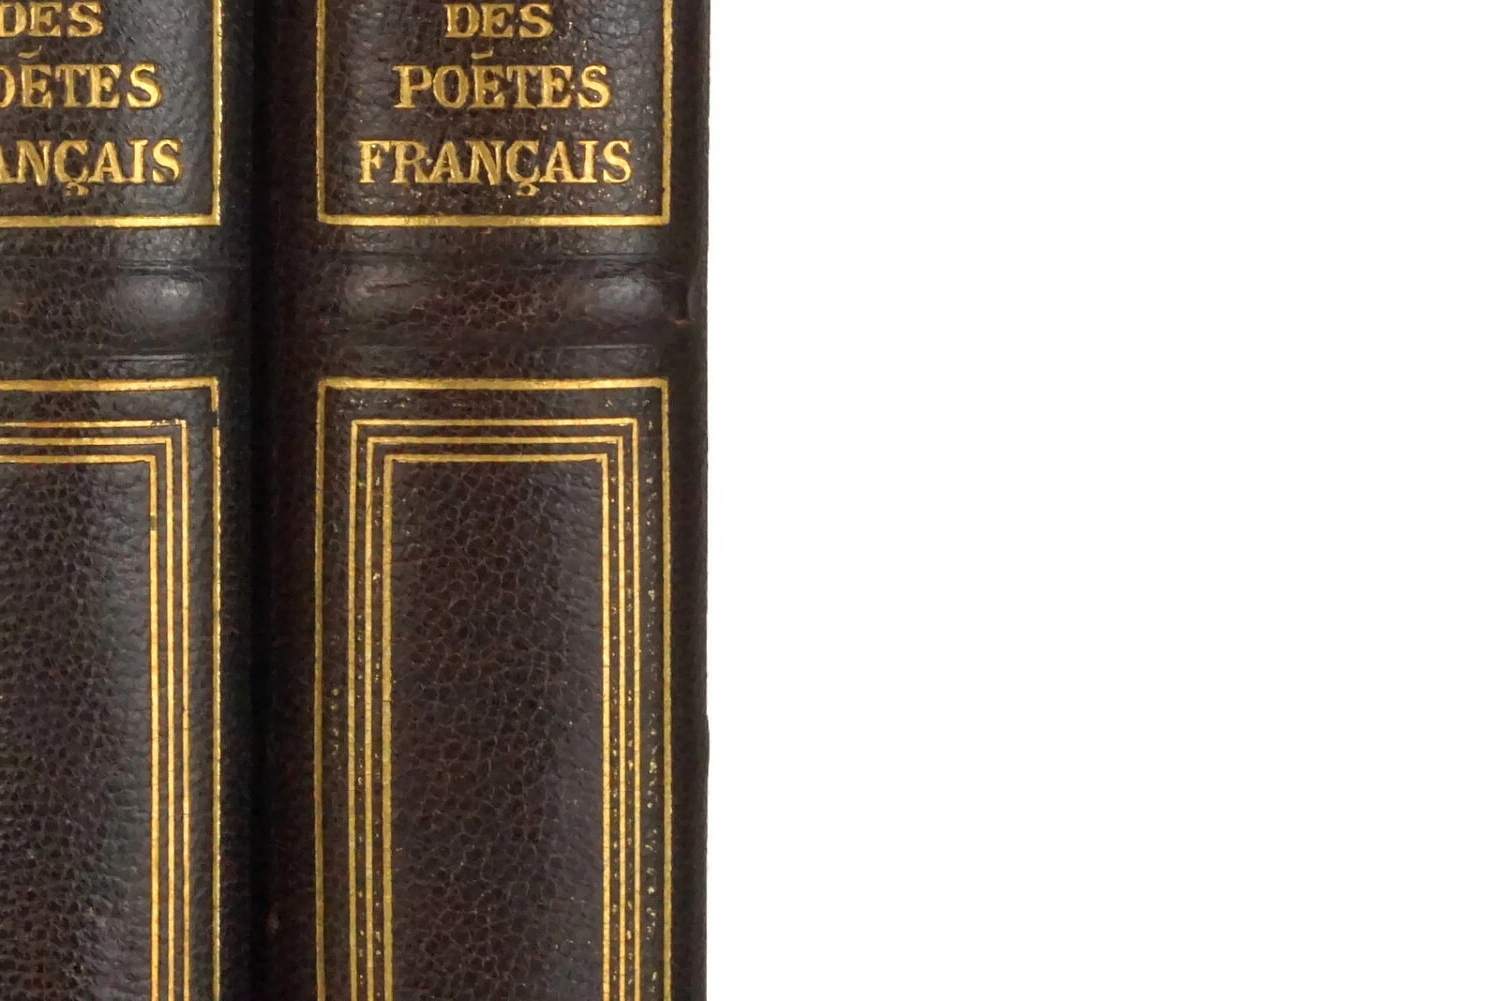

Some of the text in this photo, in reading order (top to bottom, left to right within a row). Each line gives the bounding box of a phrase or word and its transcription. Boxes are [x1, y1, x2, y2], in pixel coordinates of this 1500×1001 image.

[443, 3, 554, 39] DES
[393, 50, 612, 109] POÉTES
[357, 139, 632, 196] FRANÇAIS
